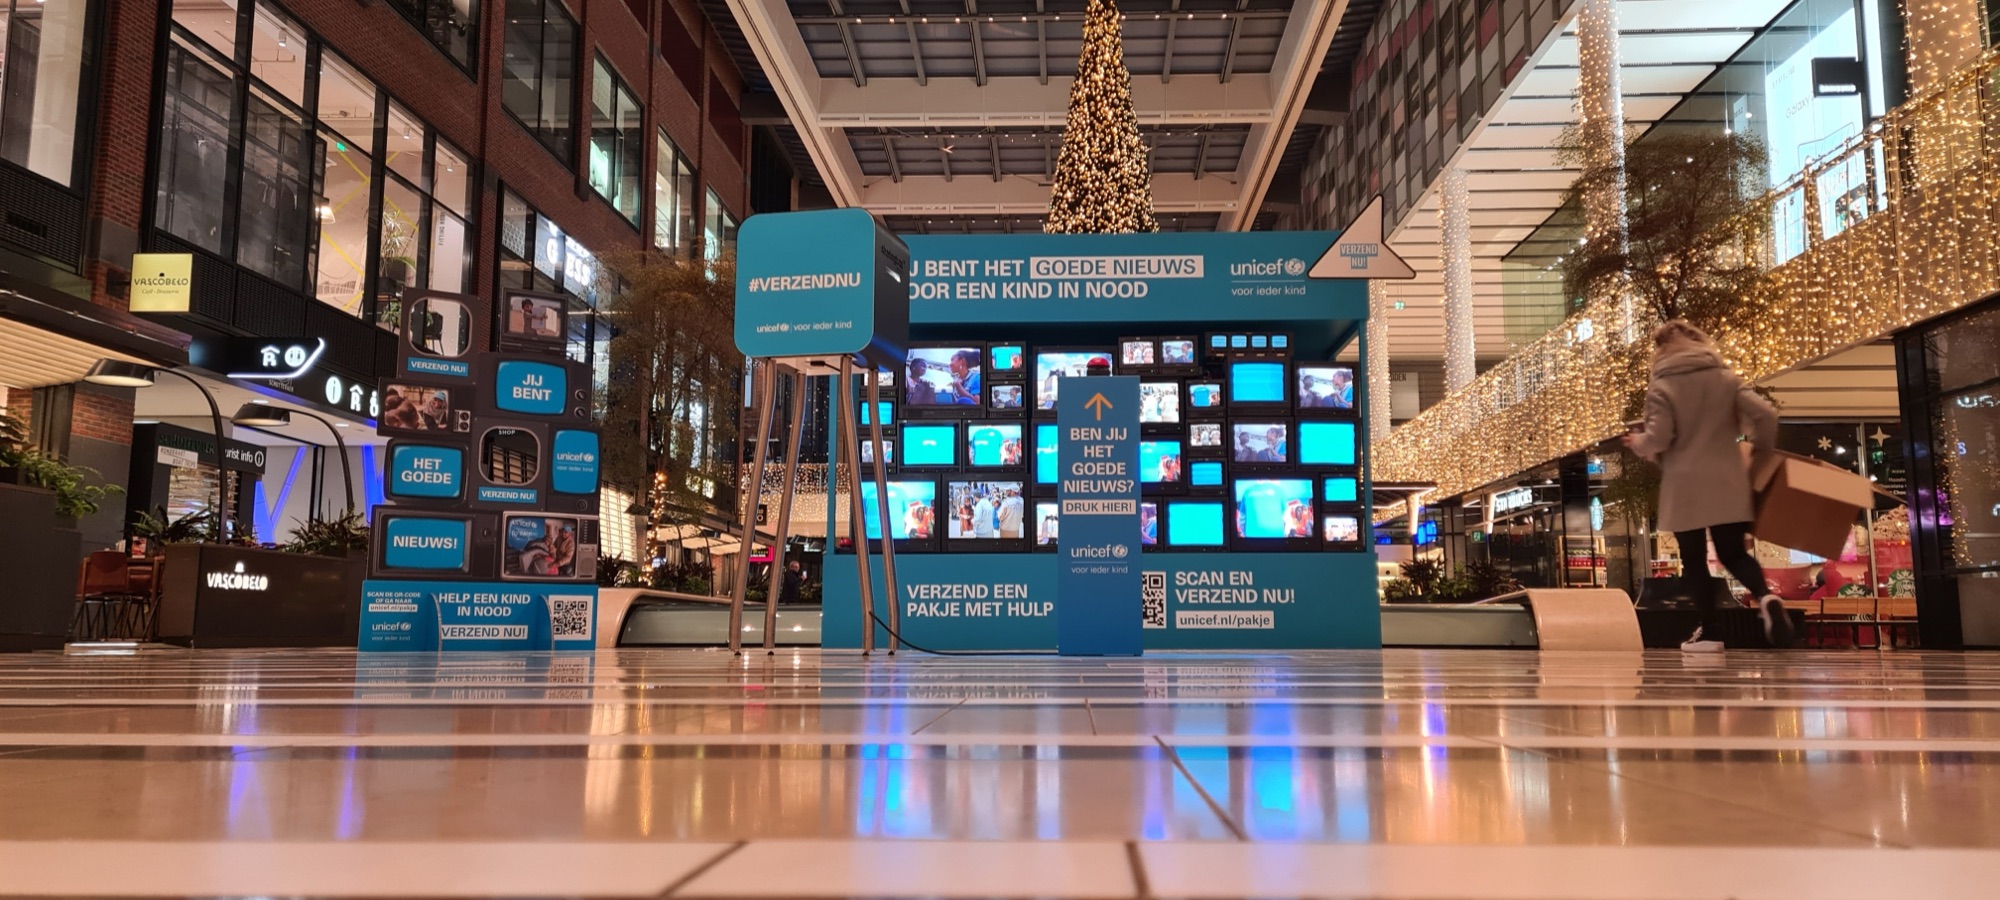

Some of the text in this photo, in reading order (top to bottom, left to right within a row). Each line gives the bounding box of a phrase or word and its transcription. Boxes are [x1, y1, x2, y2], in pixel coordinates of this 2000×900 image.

[1340, 244, 1378, 254] VERZEND
[910, 258, 1196, 277] J BENT HET GOEDE NIEUWS
[1230, 258, 1283, 276] unicef
[1351, 256, 1367, 267] NU!
[134, 278, 188, 286] VASCOBELO
[749, 272, 860, 292] #VERZENDNU
[909, 281, 1148, 299] OOR EEN KIND IN NOOD
[1232, 286, 1306, 296] voor ieder kind
[757, 323, 780, 333] unicef
[813, 322, 832, 330] ieder
[834, 320, 852, 329] kind
[411, 361, 466, 373] VERZEND NU!
[522, 374, 543, 386] JIJ
[512, 387, 552, 401] BENT
[1070, 428, 1127, 440] BEN JIJ
[225, 448, 253, 463] urist info
[556, 452, 583, 461] unicef
[1084, 445, 1114, 458] HET
[413, 458, 442, 470] HET
[1072, 462, 1126, 476] GOEDE
[401, 470, 452, 484] GOEDE
[1064, 480, 1134, 493] NIEUWS?
[482, 490, 534, 500] VERZEND NU!
[1066, 502, 1132, 512] DRUK HIER!
[394, 536, 458, 549] NIEUWS!
[1071, 544, 1112, 558] unicef
[1090, 566, 1110, 574] ieder
[1112, 566, 1128, 574] kind
[207, 572, 268, 591] VASCOBELO
[1176, 571, 1253, 586] SCAN EN
[439, 592, 531, 604] HELP EEN KIND
[907, 584, 1028, 599] VERZEND EEN
[1176, 588, 1295, 604] VERZEND NU!
[457, 606, 512, 617] IN NOOD
[907, 602, 1054, 616] PAKJE MET HULP
[372, 622, 400, 631] unicef
[1180, 614, 1270, 628] unicef.nl/pakje
[442, 626, 526, 638] VERZEND NU!
